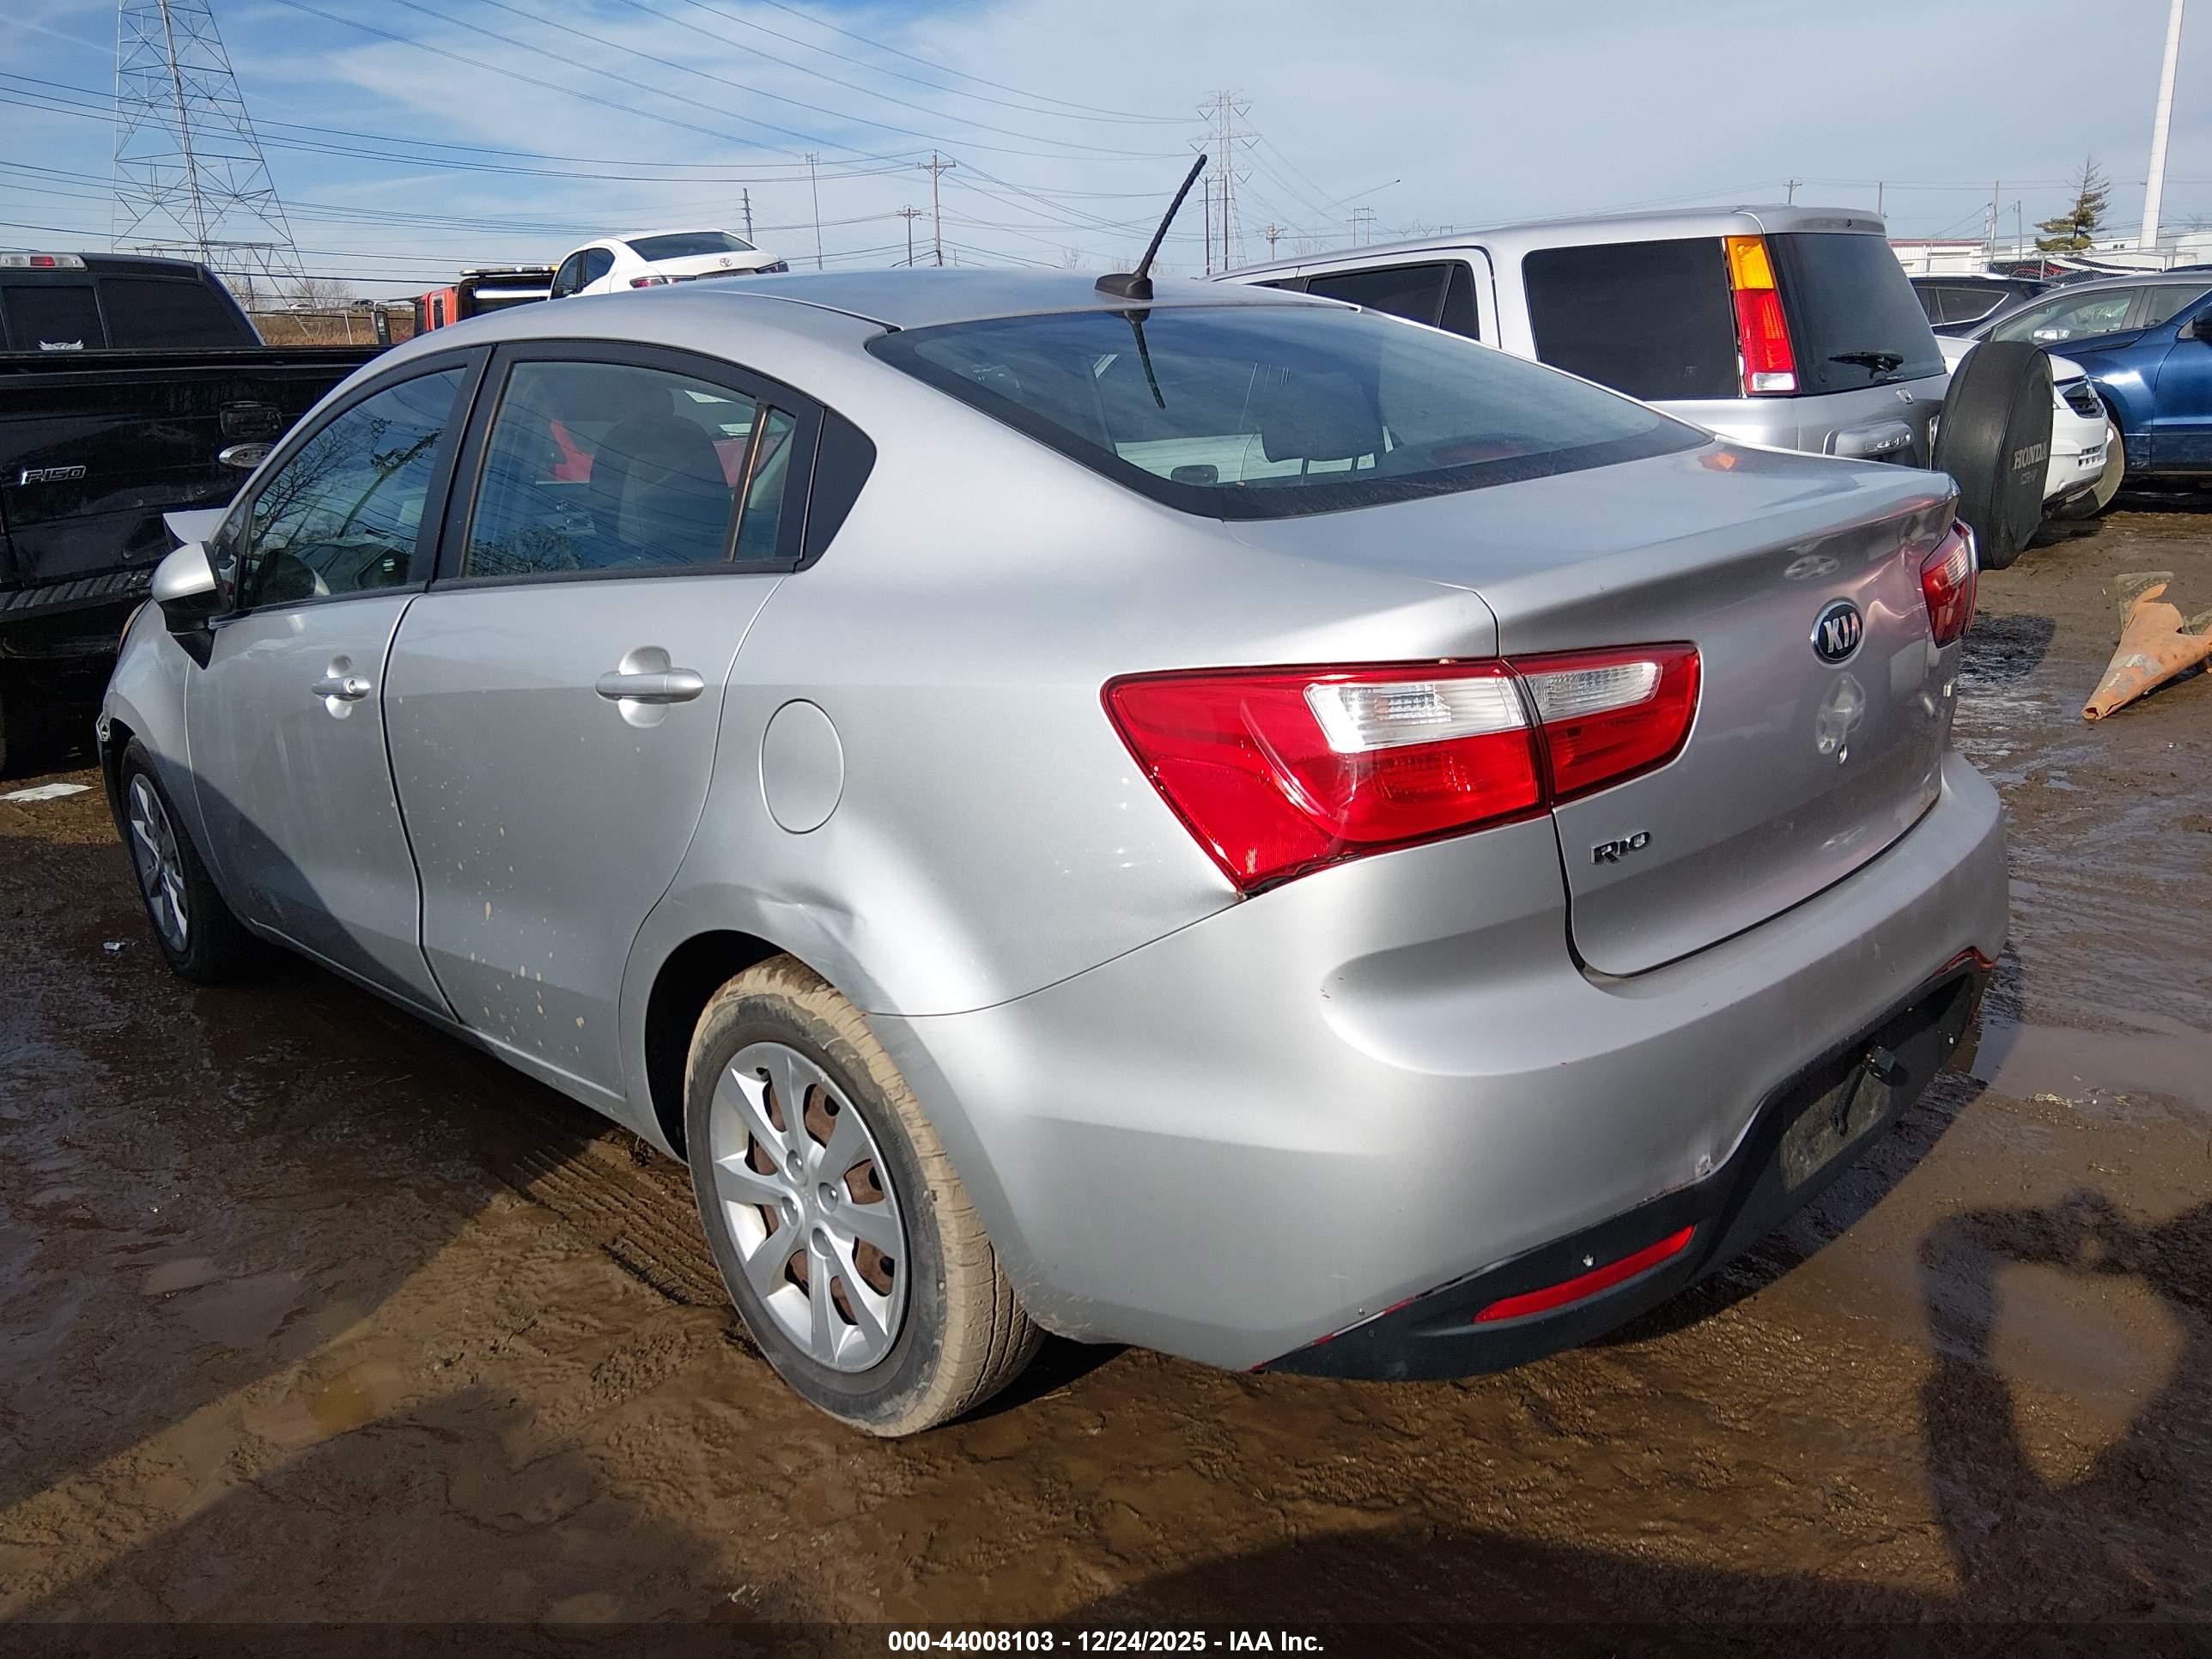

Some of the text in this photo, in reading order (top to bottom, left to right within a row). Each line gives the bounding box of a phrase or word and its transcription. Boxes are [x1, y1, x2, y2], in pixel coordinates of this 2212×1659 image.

[21, 465, 86, 485] F-150
[1823, 612, 1861, 653] KIA
[1590, 831, 1650, 865] RIO
